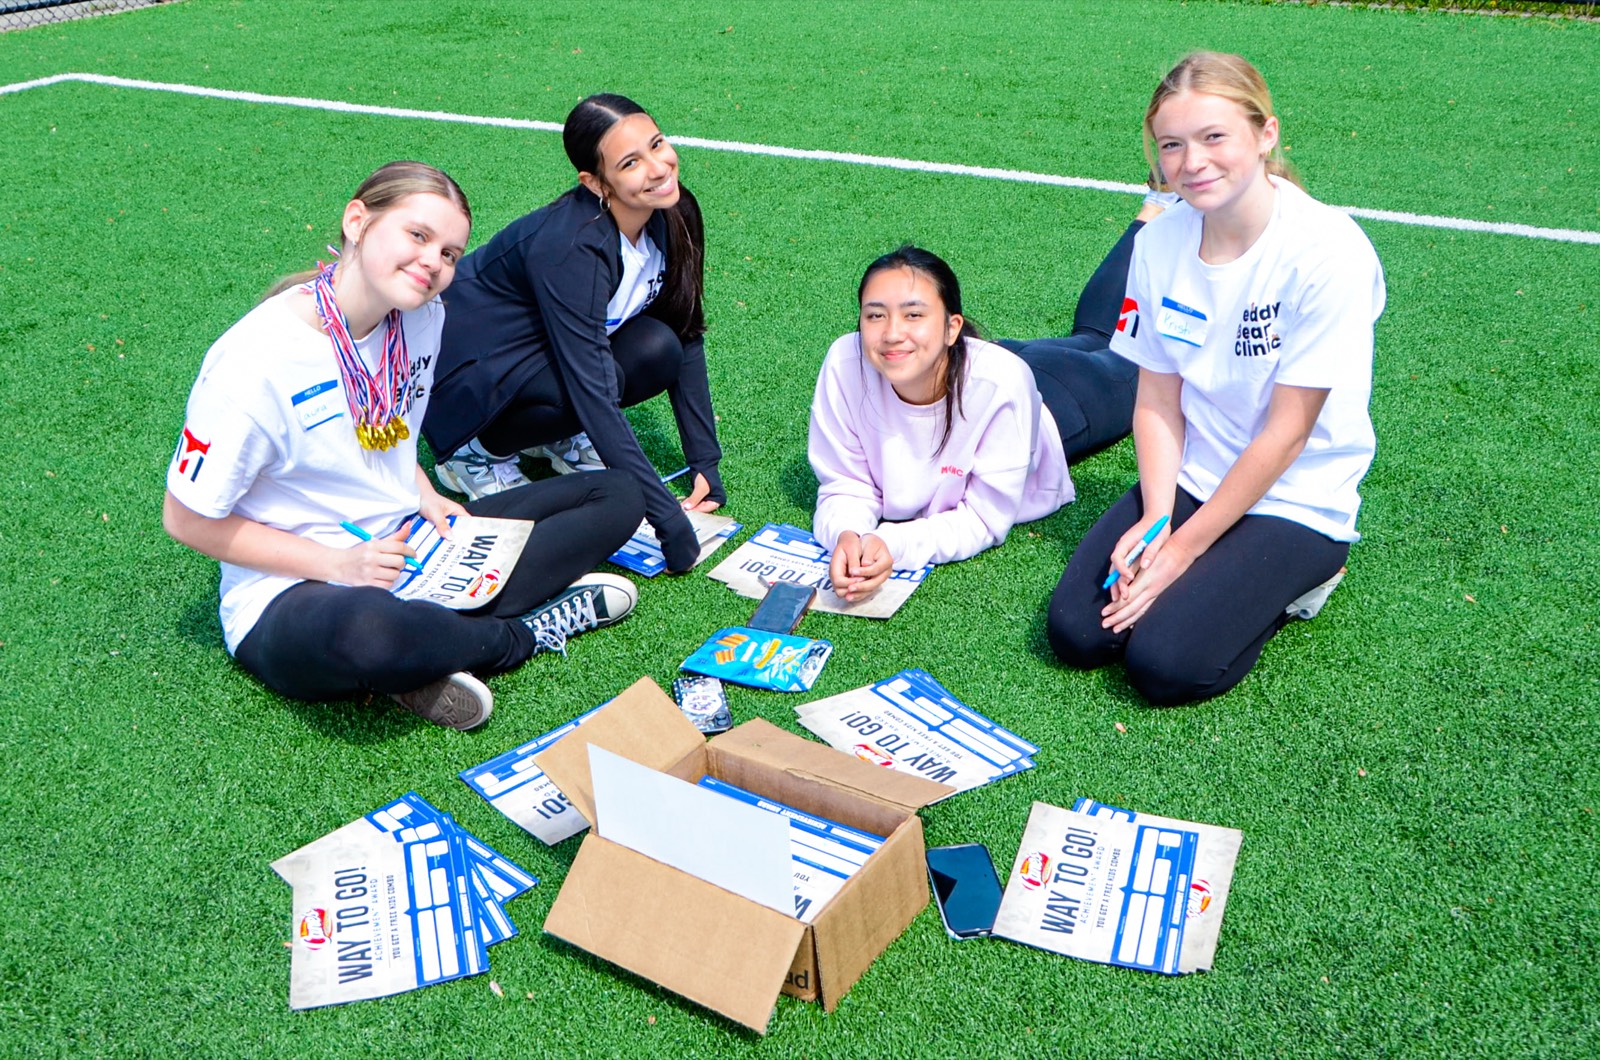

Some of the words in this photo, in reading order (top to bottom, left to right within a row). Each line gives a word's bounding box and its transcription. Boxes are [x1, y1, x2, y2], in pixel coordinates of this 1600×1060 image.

[1243, 301, 1281, 322] eddy
[1235, 336, 1281, 357] Clinic
[459, 535, 498, 572] WAY
[739, 559, 777, 576] GO!
[778, 569, 806, 583] TO
[440, 576, 474, 592] TO
[840, 711, 883, 736] GO!
[875, 734, 910, 755] TO
[902, 753, 957, 783] WAY
[1061, 826, 1098, 859] GO!
[1093, 846, 1105, 870] AWARD
[1110, 848, 1121, 867] COMBO
[334, 866, 368, 901] GO!
[386, 874, 396, 895] COMBO
[1053, 862, 1089, 886] TO
[1107, 868, 1117, 882] KIDS
[369, 878, 379, 904] AWARD
[1104, 882, 1114, 898] FREE
[388, 895, 397, 909] KIDS
[1040, 890, 1081, 934] WAY
[1099, 903, 1108, 916] GET
[336, 905, 370, 933] TO
[389, 911, 398, 927] FREE
[1096, 915, 1106, 929] YOU
[391, 933, 400, 946] GET
[337, 940, 373, 984] WAY
[392, 947, 401, 960] YOU
